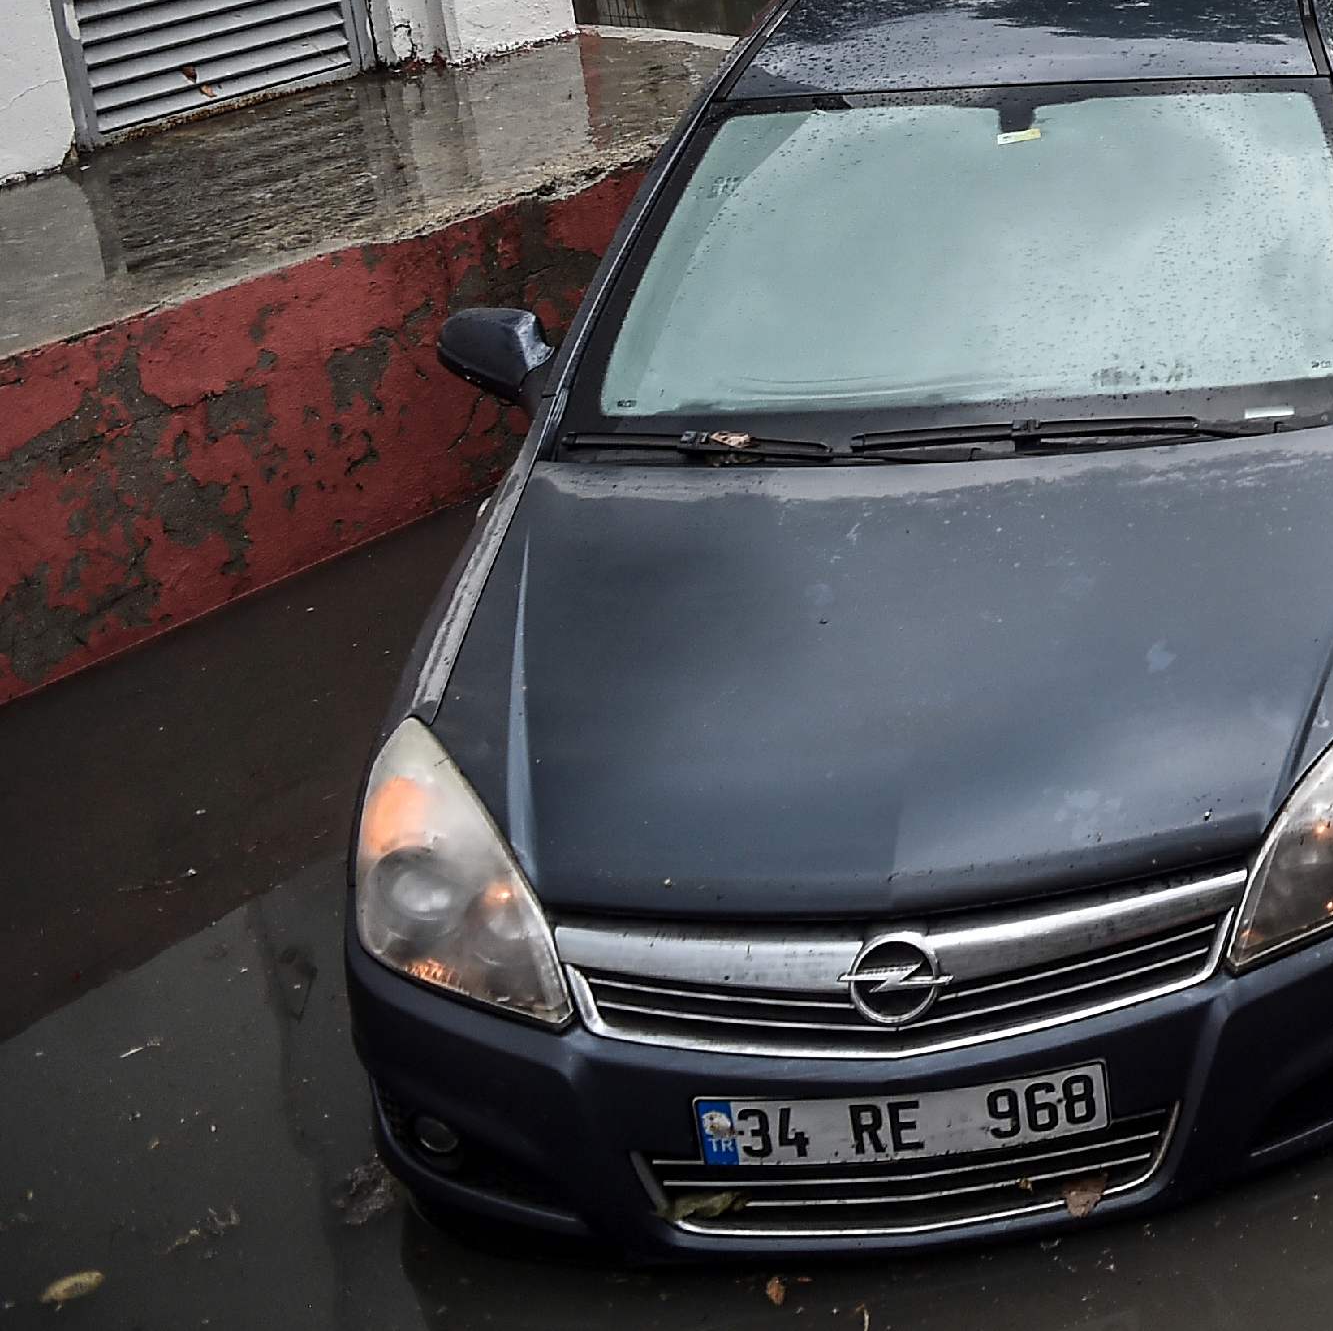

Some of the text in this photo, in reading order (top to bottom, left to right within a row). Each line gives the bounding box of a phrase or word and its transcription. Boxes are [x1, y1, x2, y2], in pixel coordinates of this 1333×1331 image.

[737, 1074, 1097, 1158] 34 RE 968
[708, 1138, 734, 1152] TR
